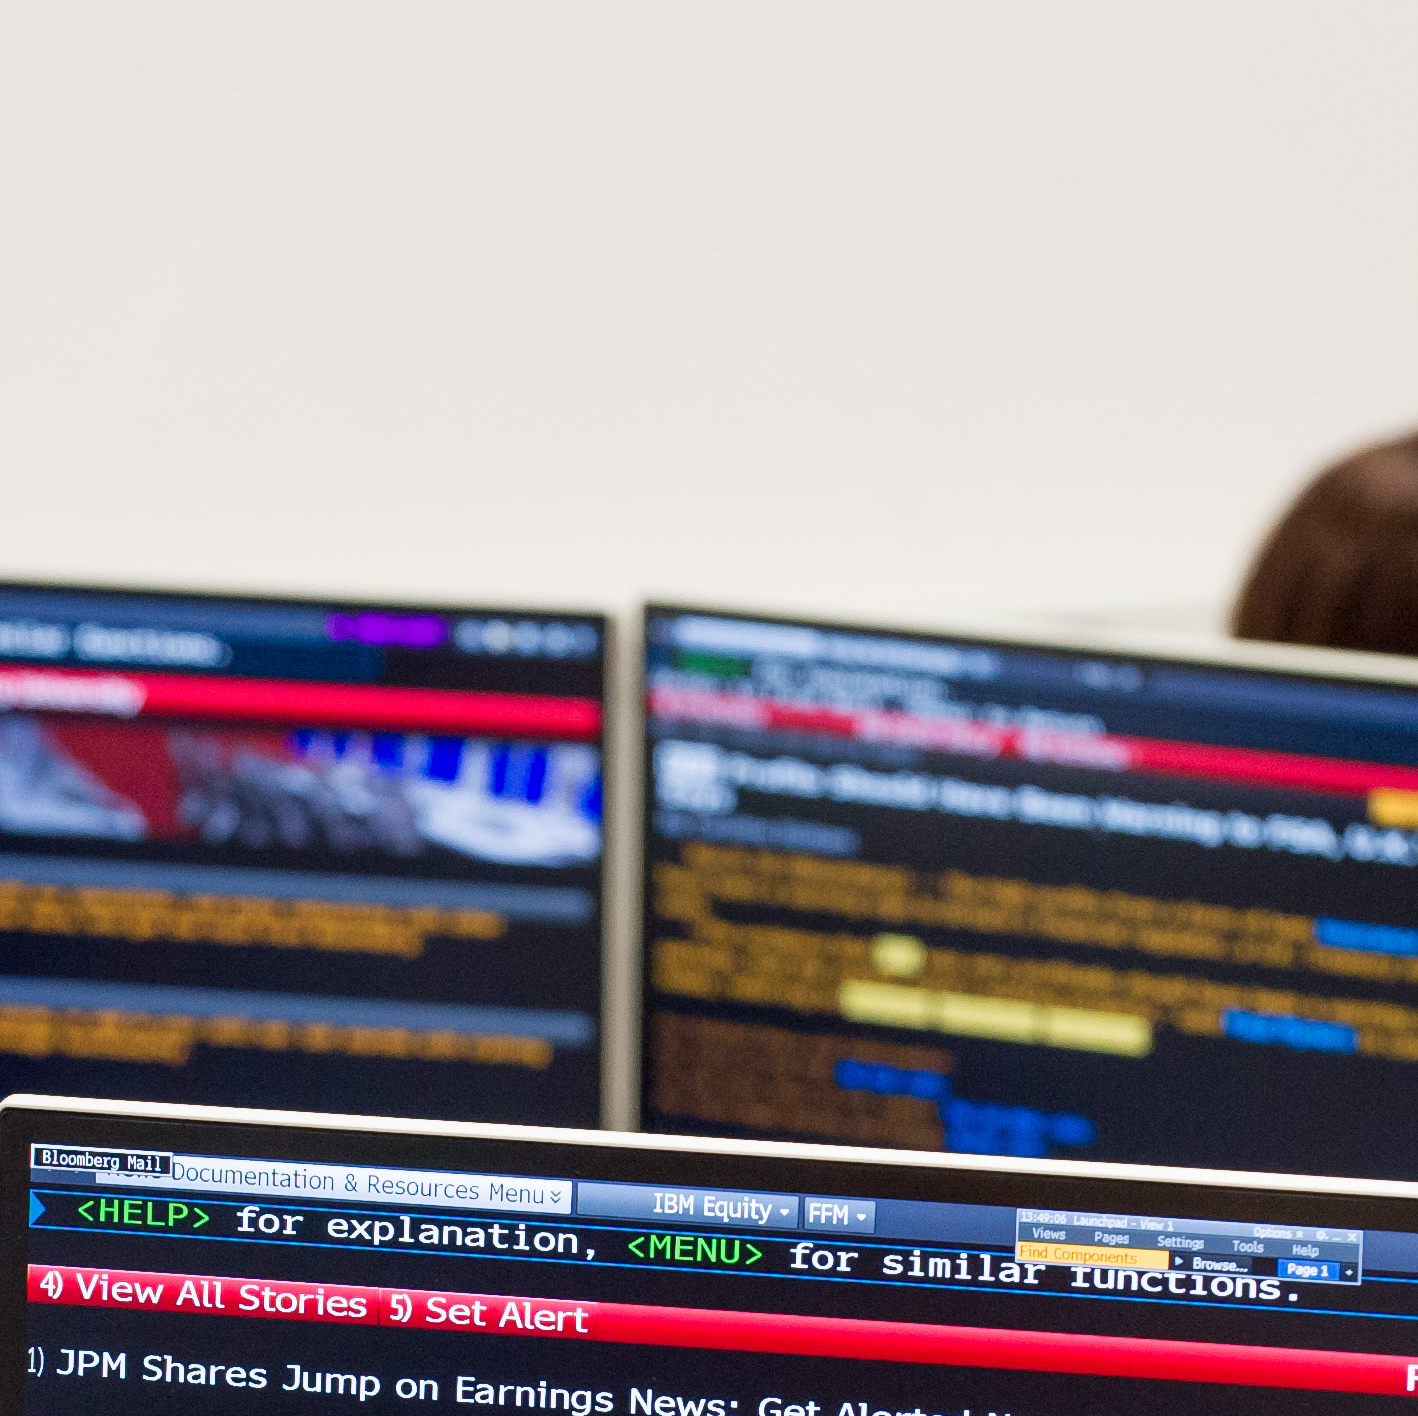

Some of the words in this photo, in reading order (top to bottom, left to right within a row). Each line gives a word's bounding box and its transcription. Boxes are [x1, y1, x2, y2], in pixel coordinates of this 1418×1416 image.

[41, 1149, 120, 1171] Bloomberg
[127, 1155, 162, 1172] Mail
[172, 1162, 335, 1192] Documentation
[344, 1172, 359, 1193] &
[367, 1174, 479, 1201] Resources
[487, 1182, 544, 1206] Menu
[652, 1192, 695, 1217] IBM
[702, 1195, 773, 1225] Equity
[808, 1203, 849, 1228] FFM
[77, 1198, 210, 1228] <HELP>
[236, 1205, 304, 1235] for
[327, 1215, 596, 1262] explanation,
[627, 1234, 763, 1265] <MENU>
[789, 1241, 859, 1272] for
[881, 1249, 1046, 1286] similar
[1019, 1245, 1049, 1261] Find
[1053, 1247, 1138, 1266] Components
[1031, 1226, 1067, 1241] Views
[1094, 1231, 1130, 1247] Pages
[1157, 1235, 1205, 1251] Settings
[1232, 1240, 1265, 1255] Tools
[1292, 1243, 1321, 1259] Help
[1286, 1262, 1319, 1278] Page
[39, 1270, 64, 1300] 4)
[75, 1272, 165, 1304] View
[175, 1279, 225, 1309] All
[238, 1283, 367, 1318] Stories
[389, 1293, 413, 1323] 5)
[425, 1296, 488, 1327] Set
[498, 1301, 589, 1333] Alert
[27, 1346, 45, 1378] 1)
[56, 1348, 126, 1380] JPM
[142, 1354, 268, 1389] Shares
[282, 1364, 381, 1402] Jump
[395, 1378, 439, 1401] on
[456, 1375, 614, 1416] Earnings
